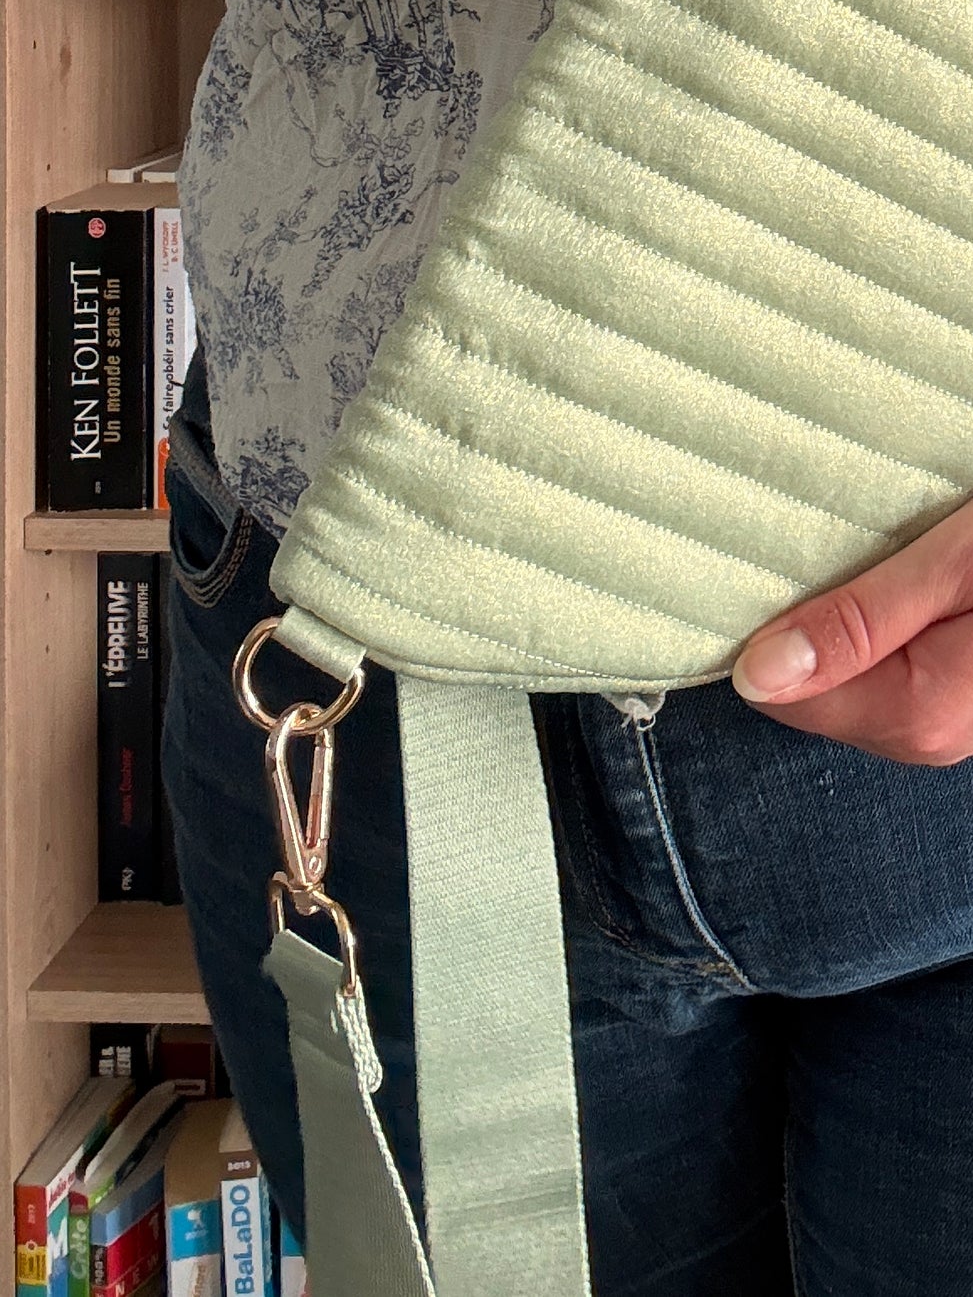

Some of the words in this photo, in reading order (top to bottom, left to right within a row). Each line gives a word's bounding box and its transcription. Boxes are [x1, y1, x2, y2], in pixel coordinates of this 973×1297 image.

[104, 278, 121, 300] fin
[162, 286, 174, 315] crier
[70, 262, 101, 386] FOLLETT
[107, 305, 121, 347] sans
[165, 317, 174, 345] sans
[104, 355, 121, 413] monde
[70, 399, 101, 461] KEN
[104, 420, 121, 443] Un
[102, 580, 130, 688] L'ÉPREUVE
[136, 582, 149, 644] LABYRINTHE
[137, 647, 149, 660] LE
[229, 1184, 254, 1294] BaLaDO
